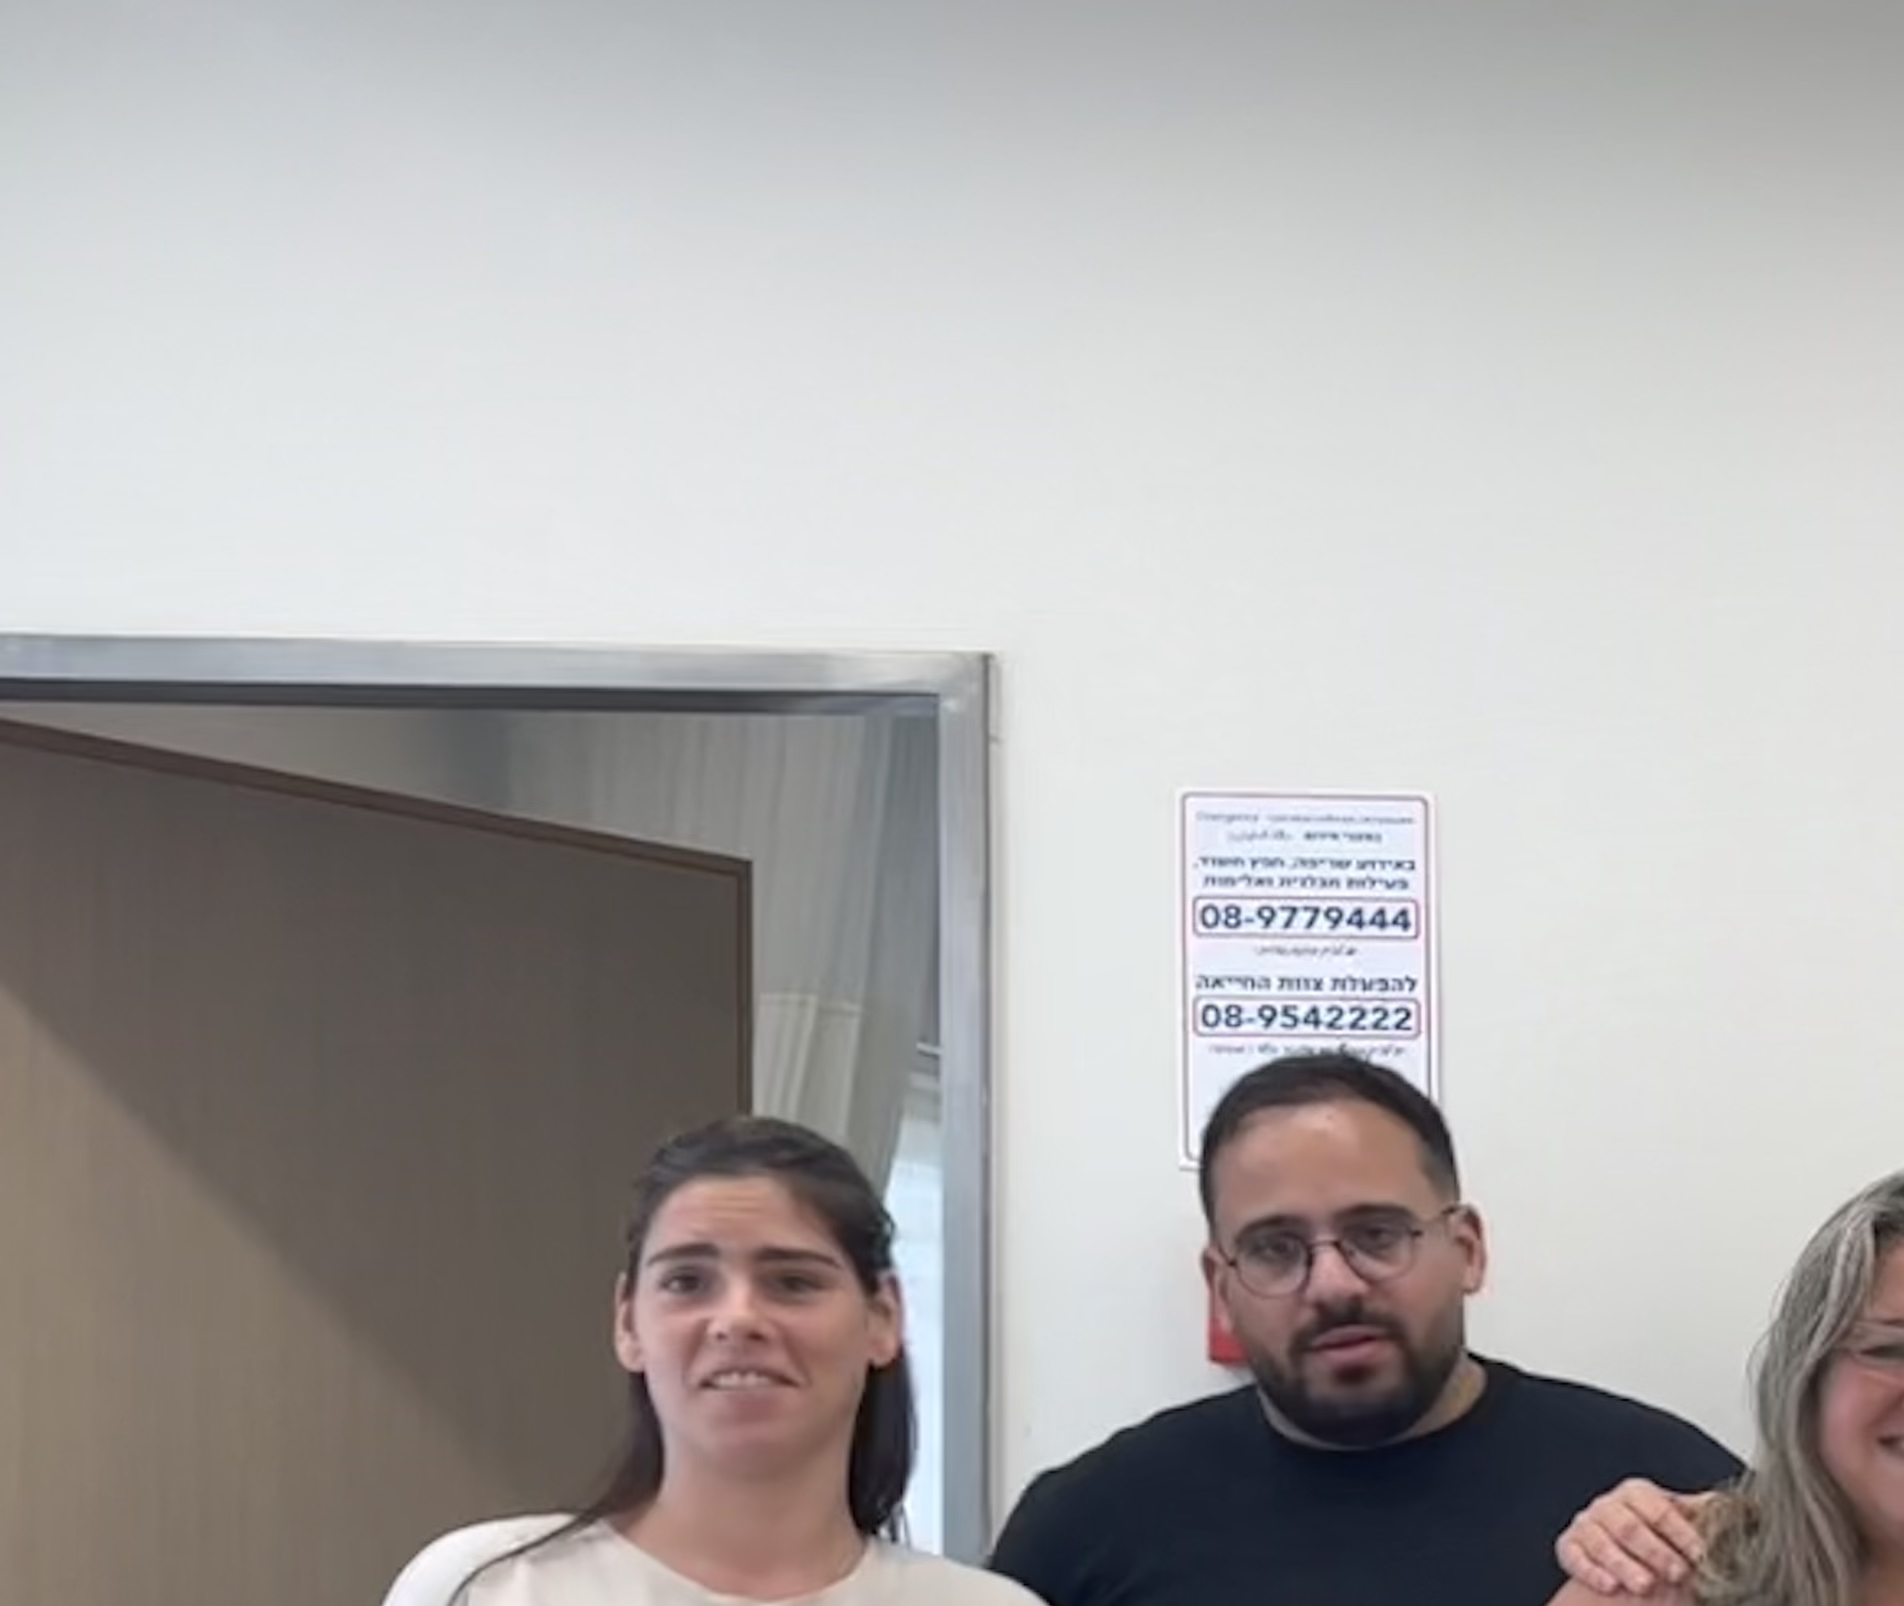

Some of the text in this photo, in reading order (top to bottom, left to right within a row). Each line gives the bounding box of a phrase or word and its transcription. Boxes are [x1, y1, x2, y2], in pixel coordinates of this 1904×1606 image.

[1346, 874, 1409, 890] פעילות
[1200, 904, 1412, 932] 08-9779444
[1195, 974, 1418, 993] להפעלת צוות החייאה
[1201, 1003, 1413, 1031] 08-9542222
